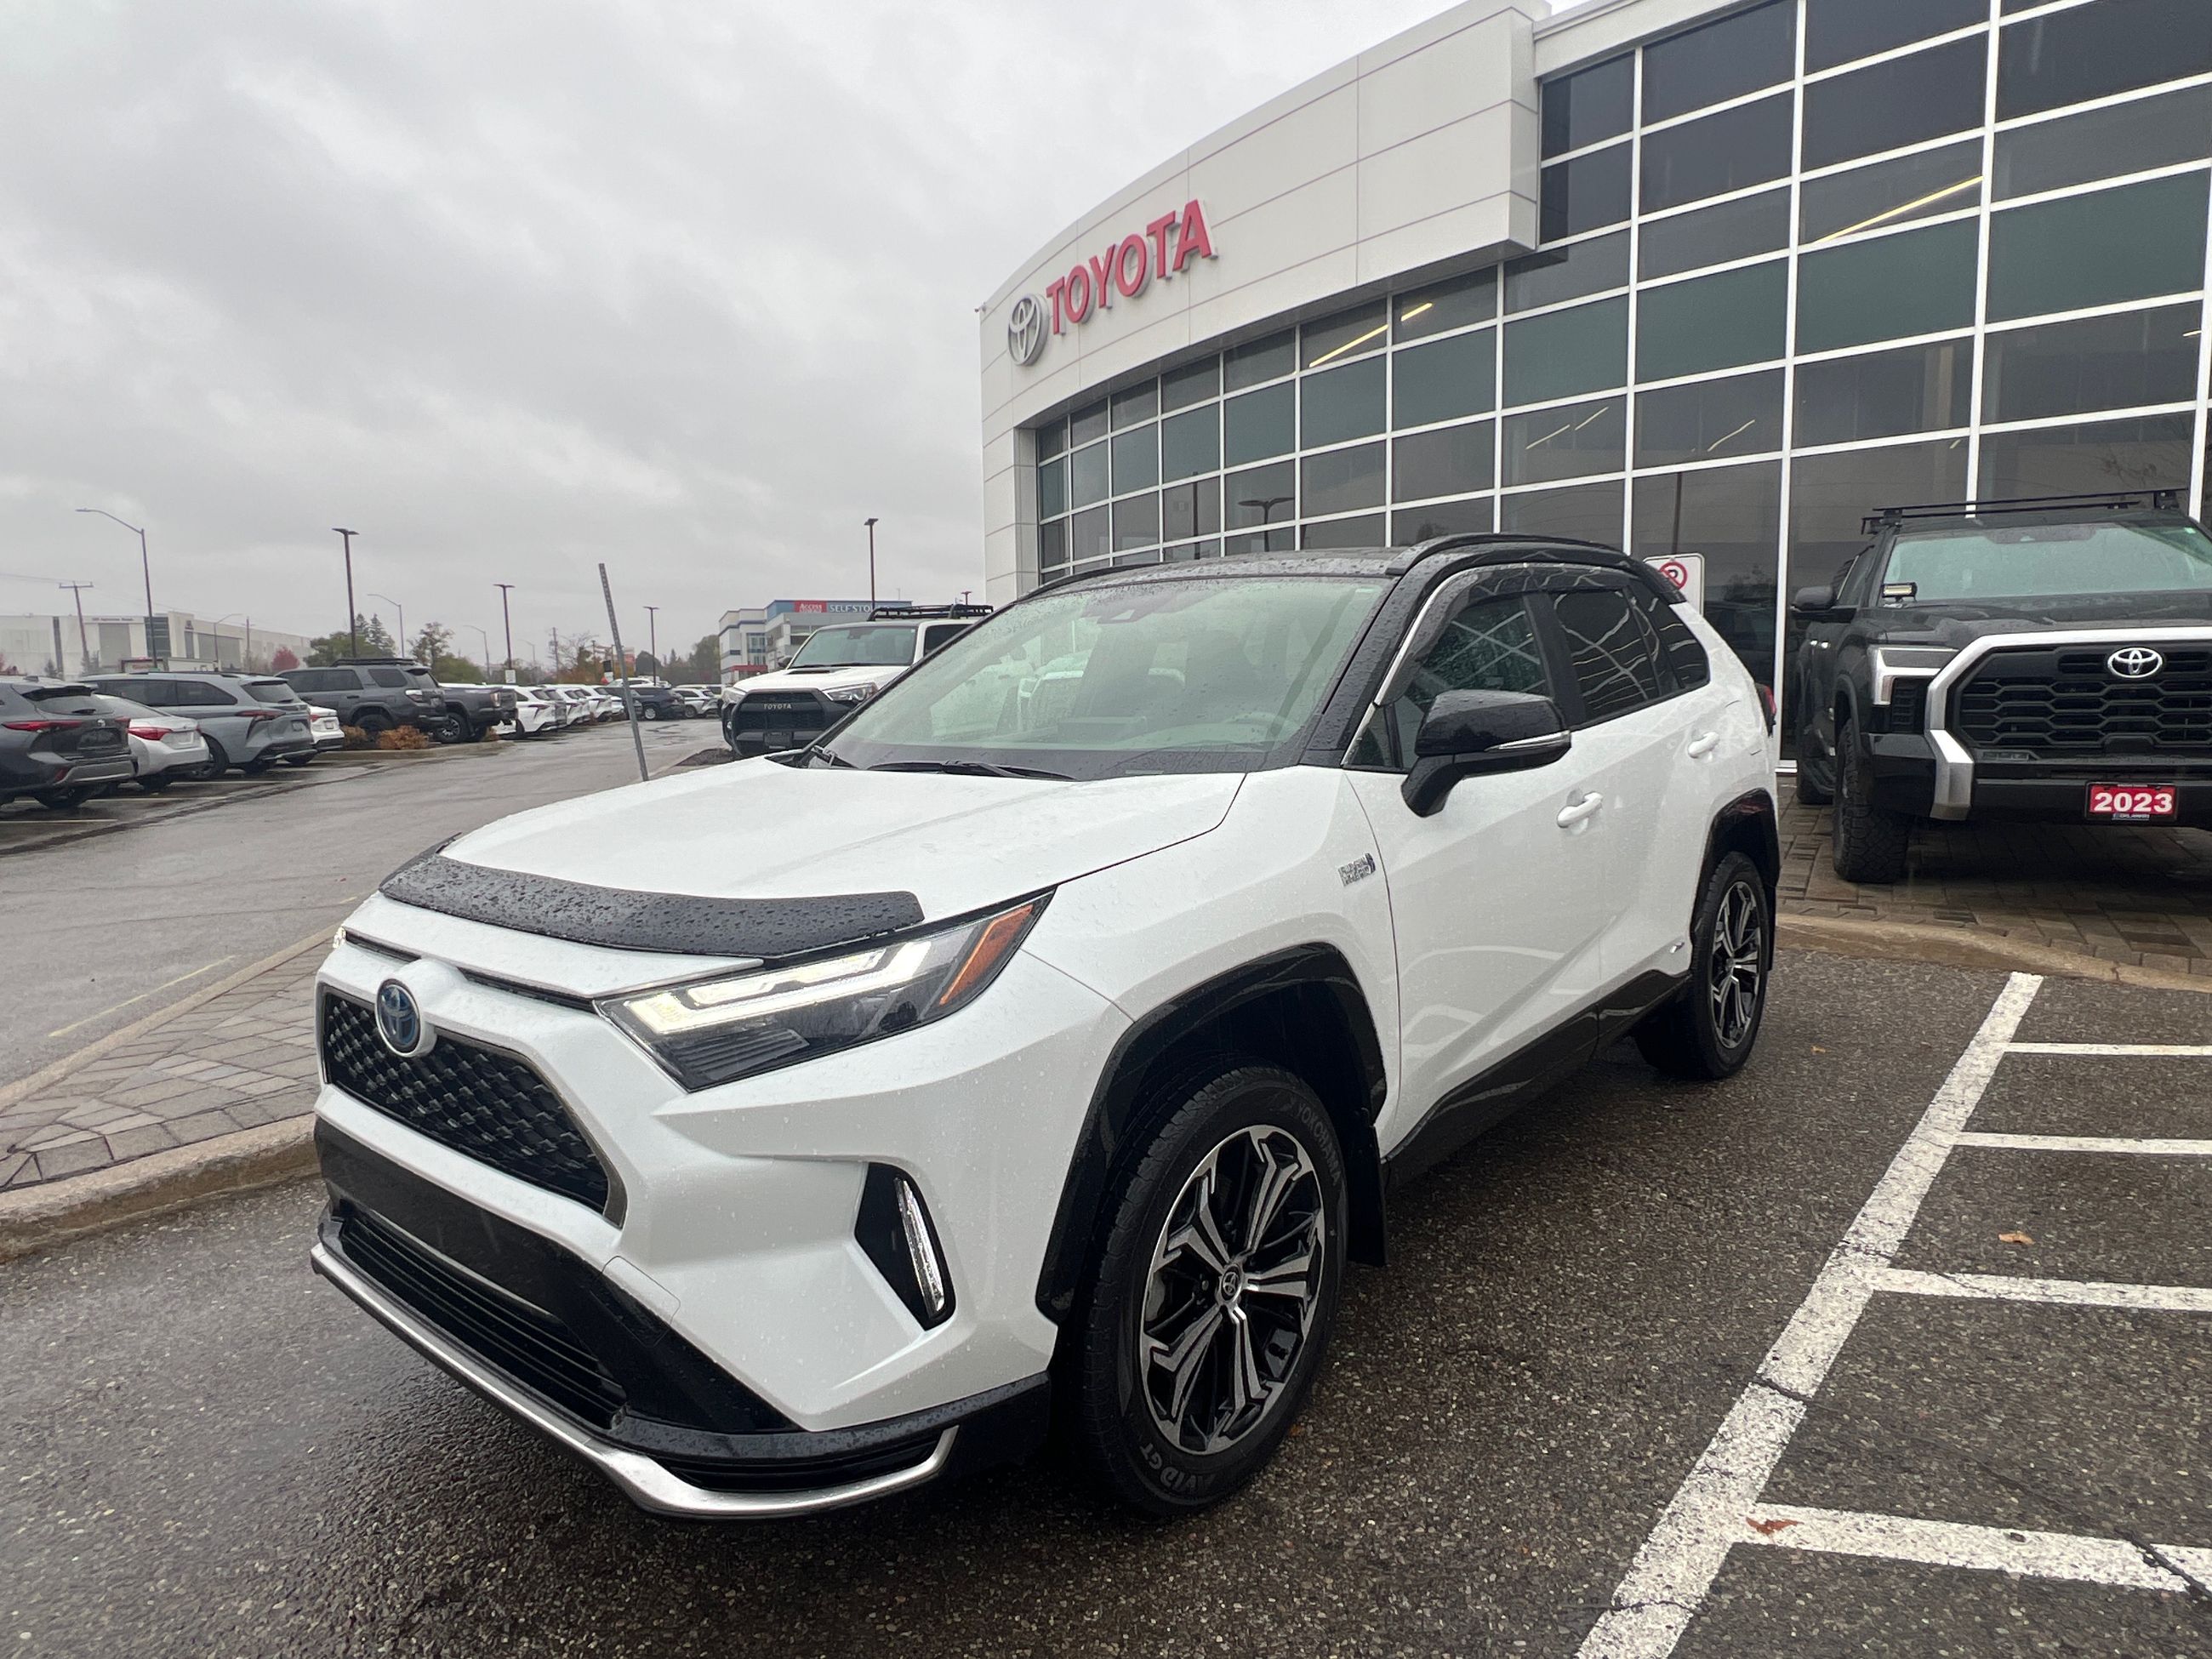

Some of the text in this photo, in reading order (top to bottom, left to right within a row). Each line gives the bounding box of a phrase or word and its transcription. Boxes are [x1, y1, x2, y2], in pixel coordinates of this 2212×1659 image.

[1046, 198, 1214, 335] TOYOTA
[830, 604, 852, 613] SELF
[2094, 792, 2173, 812] 2023
